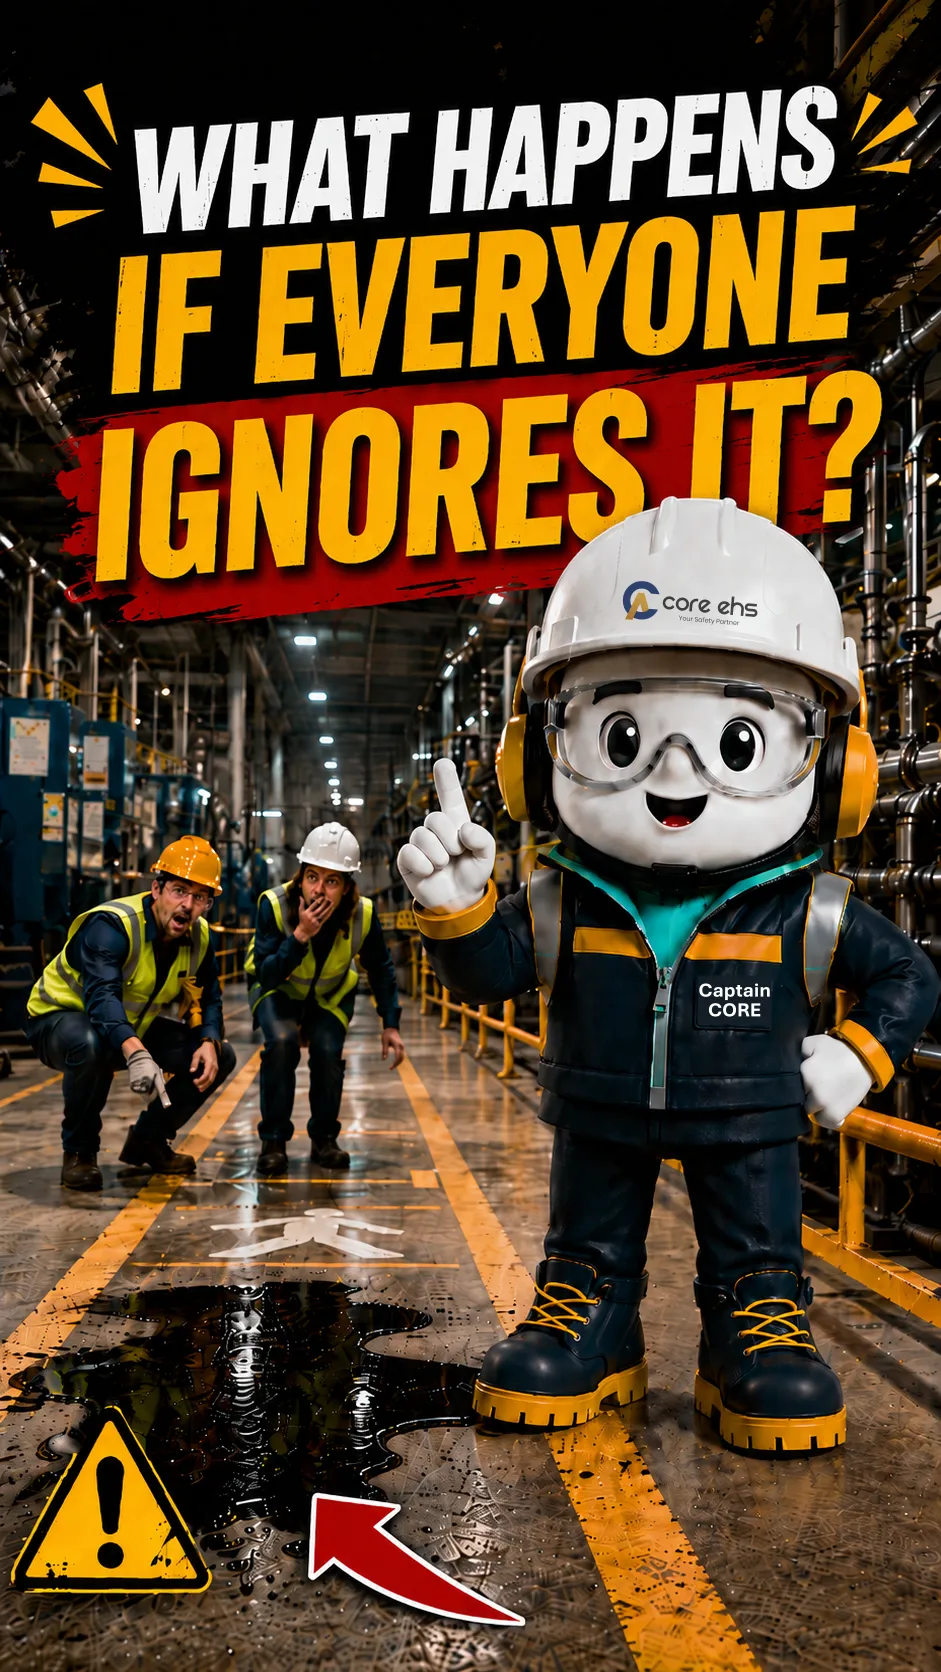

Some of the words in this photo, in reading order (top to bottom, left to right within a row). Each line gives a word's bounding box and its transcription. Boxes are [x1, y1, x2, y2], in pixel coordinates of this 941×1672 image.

[662, 596, 711, 613] core
[717, 597, 758, 617] ehs
[694, 616, 715, 625] Safety
[715, 618, 740, 626] Partner
[698, 983, 771, 1001] Captain
[708, 1003, 761, 1017] CORE
